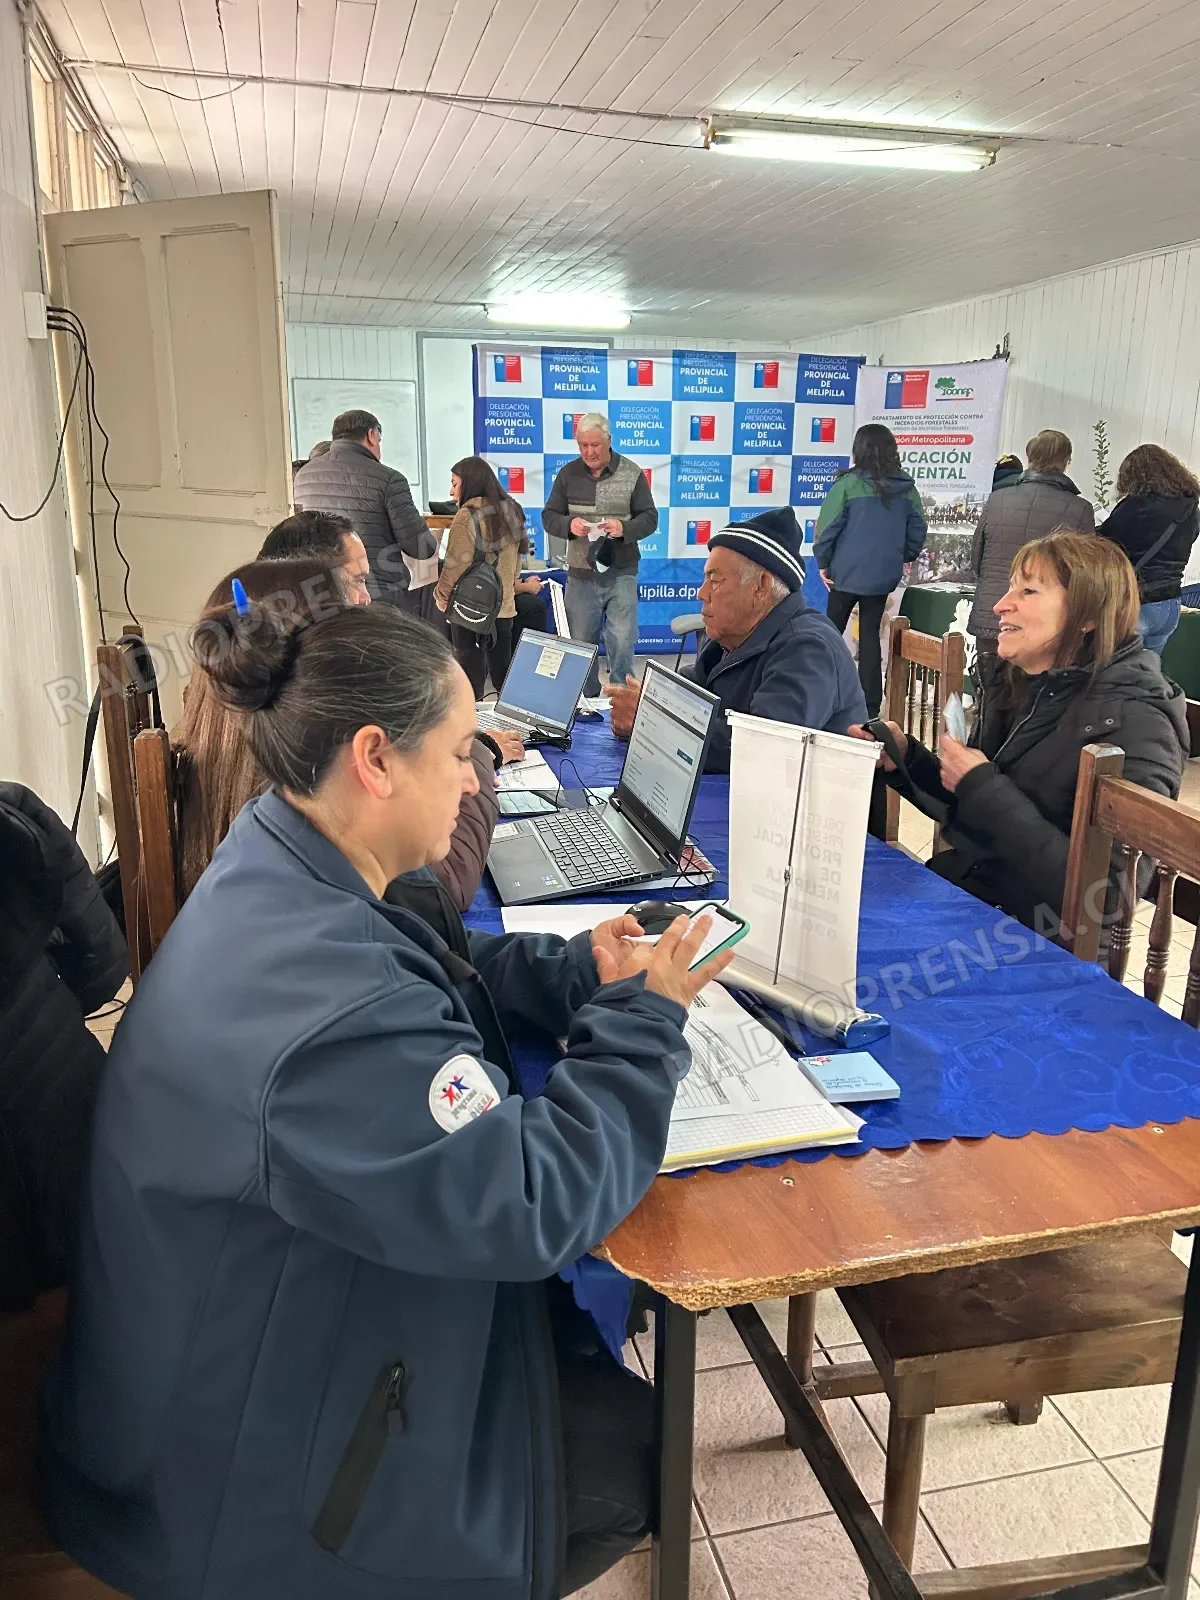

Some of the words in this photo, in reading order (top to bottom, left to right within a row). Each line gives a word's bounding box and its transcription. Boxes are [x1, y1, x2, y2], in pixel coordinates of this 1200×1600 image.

[550, 365, 600, 373] PROVINCIAL
[680, 368, 728, 376] PROVINCIAL
[804, 371, 850, 379] PROVINCIAL
[554, 383, 596, 391] MELIPILLA
[489, 437, 532, 445] MELIPILLA
[912, 436, 966, 444] Metropolitana
[900, 448, 972, 464] UCACIÓN
